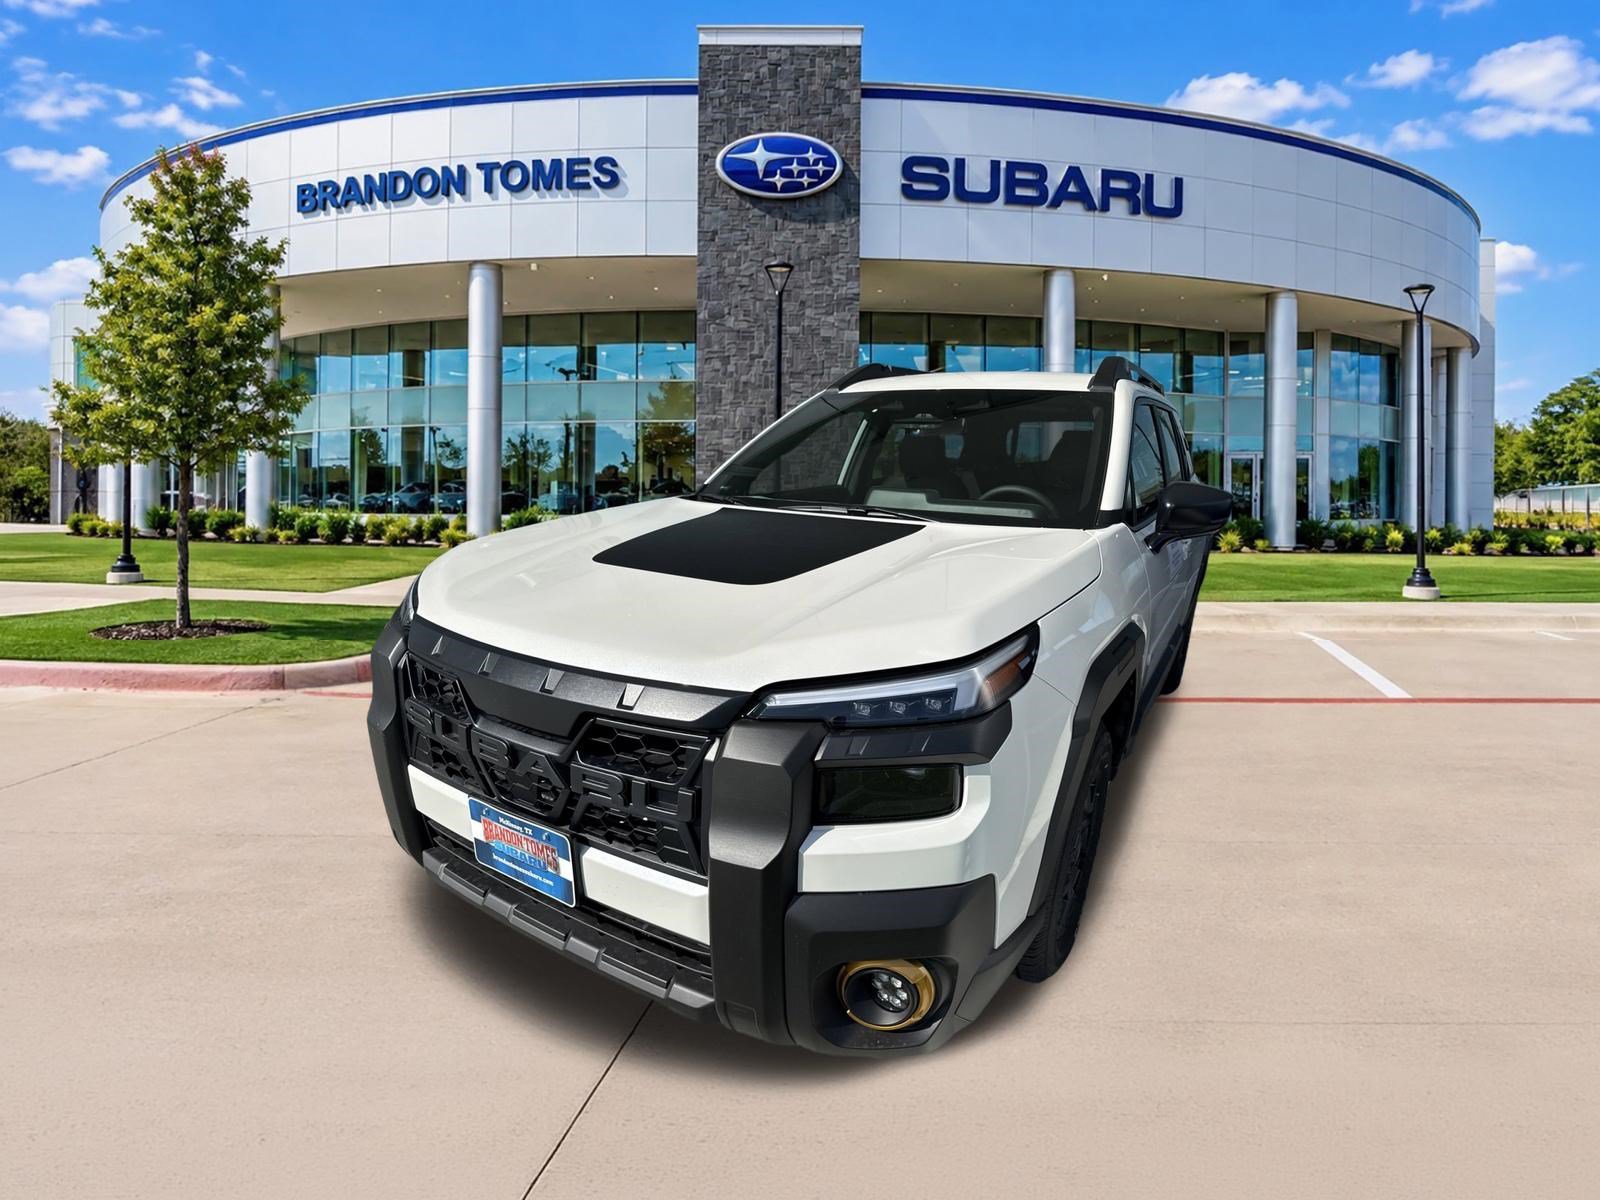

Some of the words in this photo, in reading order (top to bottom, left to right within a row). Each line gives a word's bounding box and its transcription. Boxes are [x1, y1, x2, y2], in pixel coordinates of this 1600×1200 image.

[296, 164, 466, 213] BRANDON
[476, 156, 620, 194] TOMES
[901, 155, 1184, 218] SUBARU
[404, 699, 696, 829] SUBARU
[482, 817, 523, 849] BRANDON
[522, 838, 560, 874] TOMES
[493, 841, 549, 872] SUBARU
